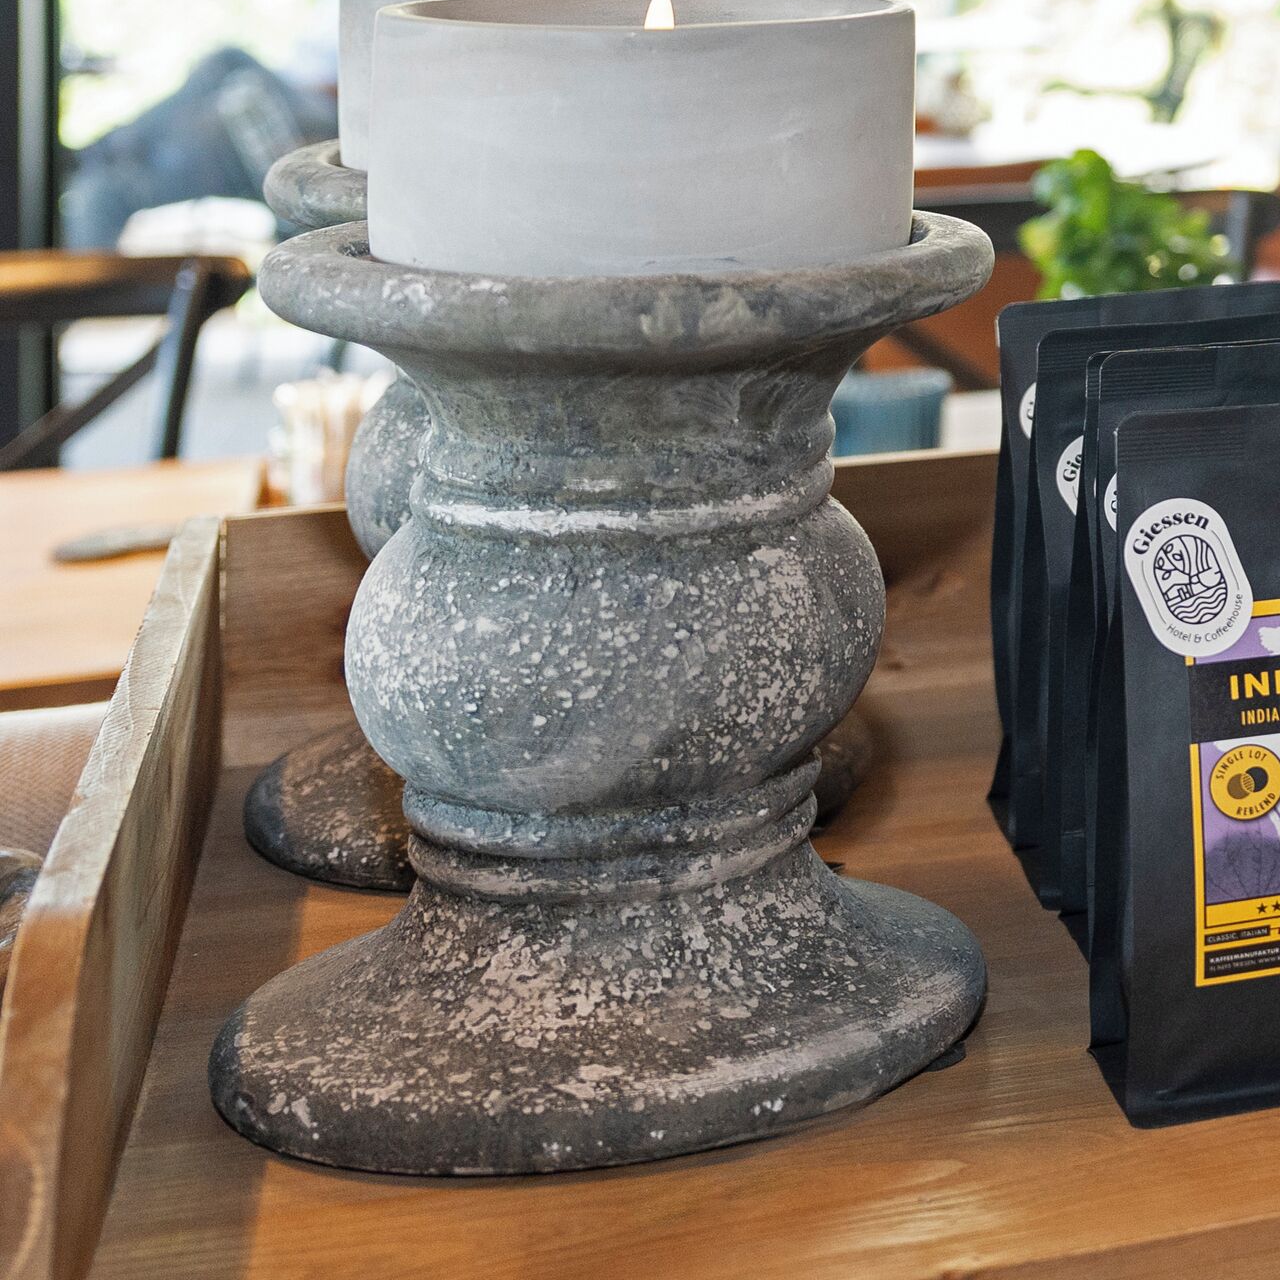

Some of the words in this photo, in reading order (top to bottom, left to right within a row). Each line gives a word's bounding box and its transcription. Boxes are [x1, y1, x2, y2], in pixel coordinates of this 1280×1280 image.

[1132, 512, 1210, 555] Giessen
[1166, 623, 1192, 643] Hotel
[1193, 634, 1202, 644] &
[1204, 593, 1243, 642] Coffeehouse
[1215, 750, 1244, 780] SINGLE
[1248, 749, 1268, 762] LOT
[1236, 792, 1276, 816] REBLEND
[1240, 928, 1268, 939] ITALIAN
[1209, 946, 1279, 964] KAFFEEMANUFAKTUR
